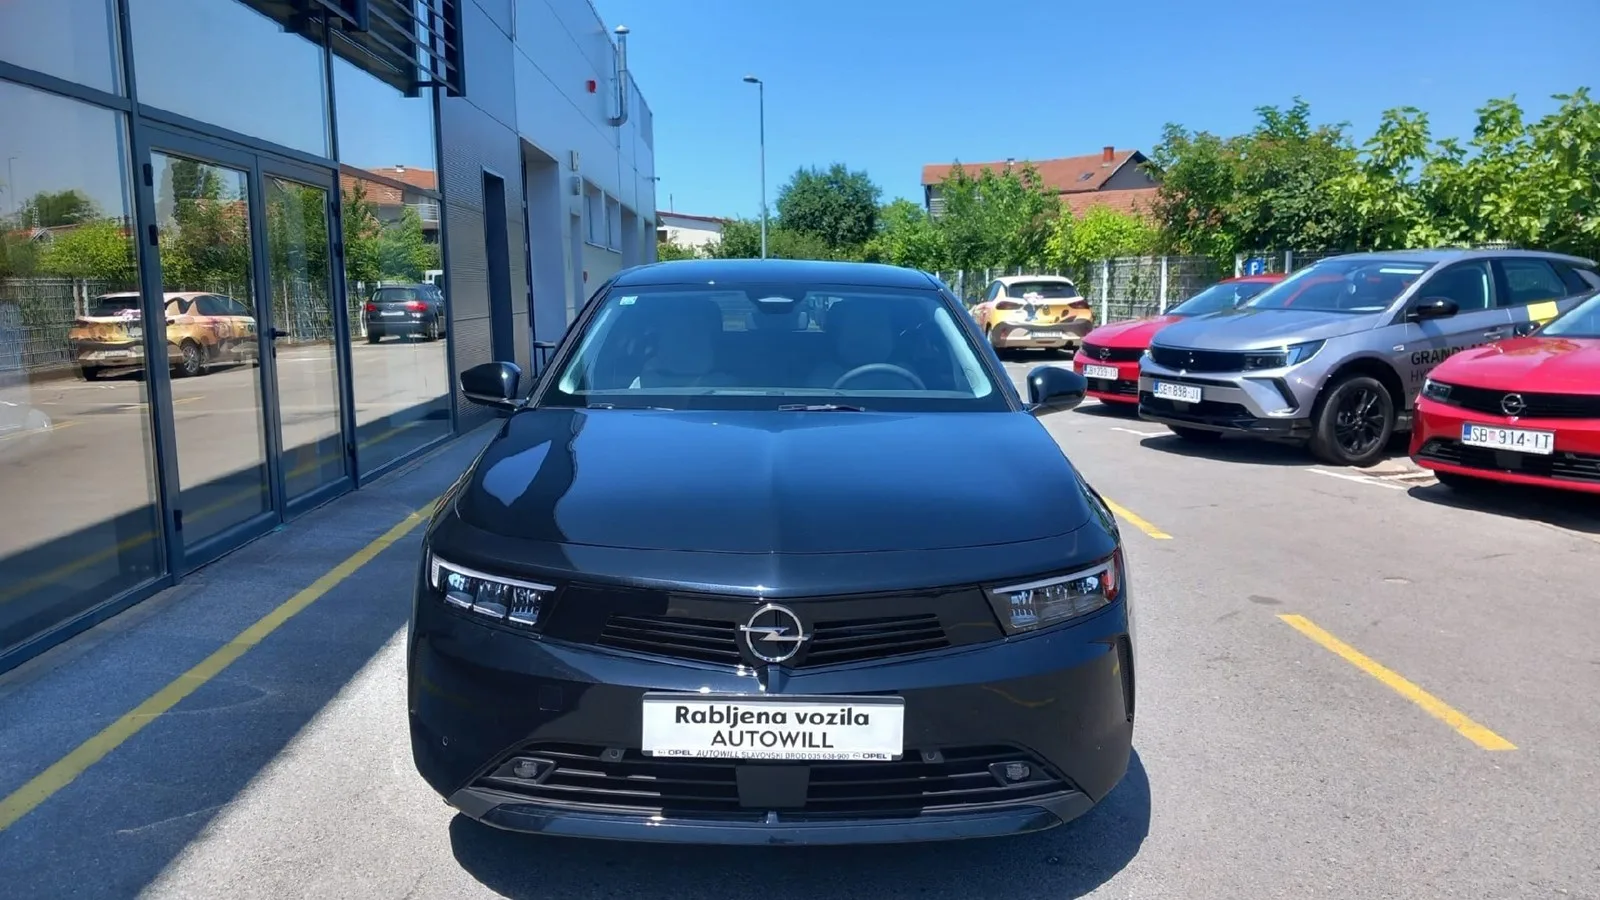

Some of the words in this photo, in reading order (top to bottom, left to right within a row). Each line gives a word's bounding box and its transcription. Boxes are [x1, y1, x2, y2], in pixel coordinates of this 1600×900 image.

[1472, 427, 1488, 443] SB
[1498, 430, 1552, 450] 914-IT
[675, 705, 786, 728] Rabljena
[795, 707, 870, 726] vozila
[711, 730, 834, 749] AUTOWILL
[696, 749, 740, 758] AUTOWILL
